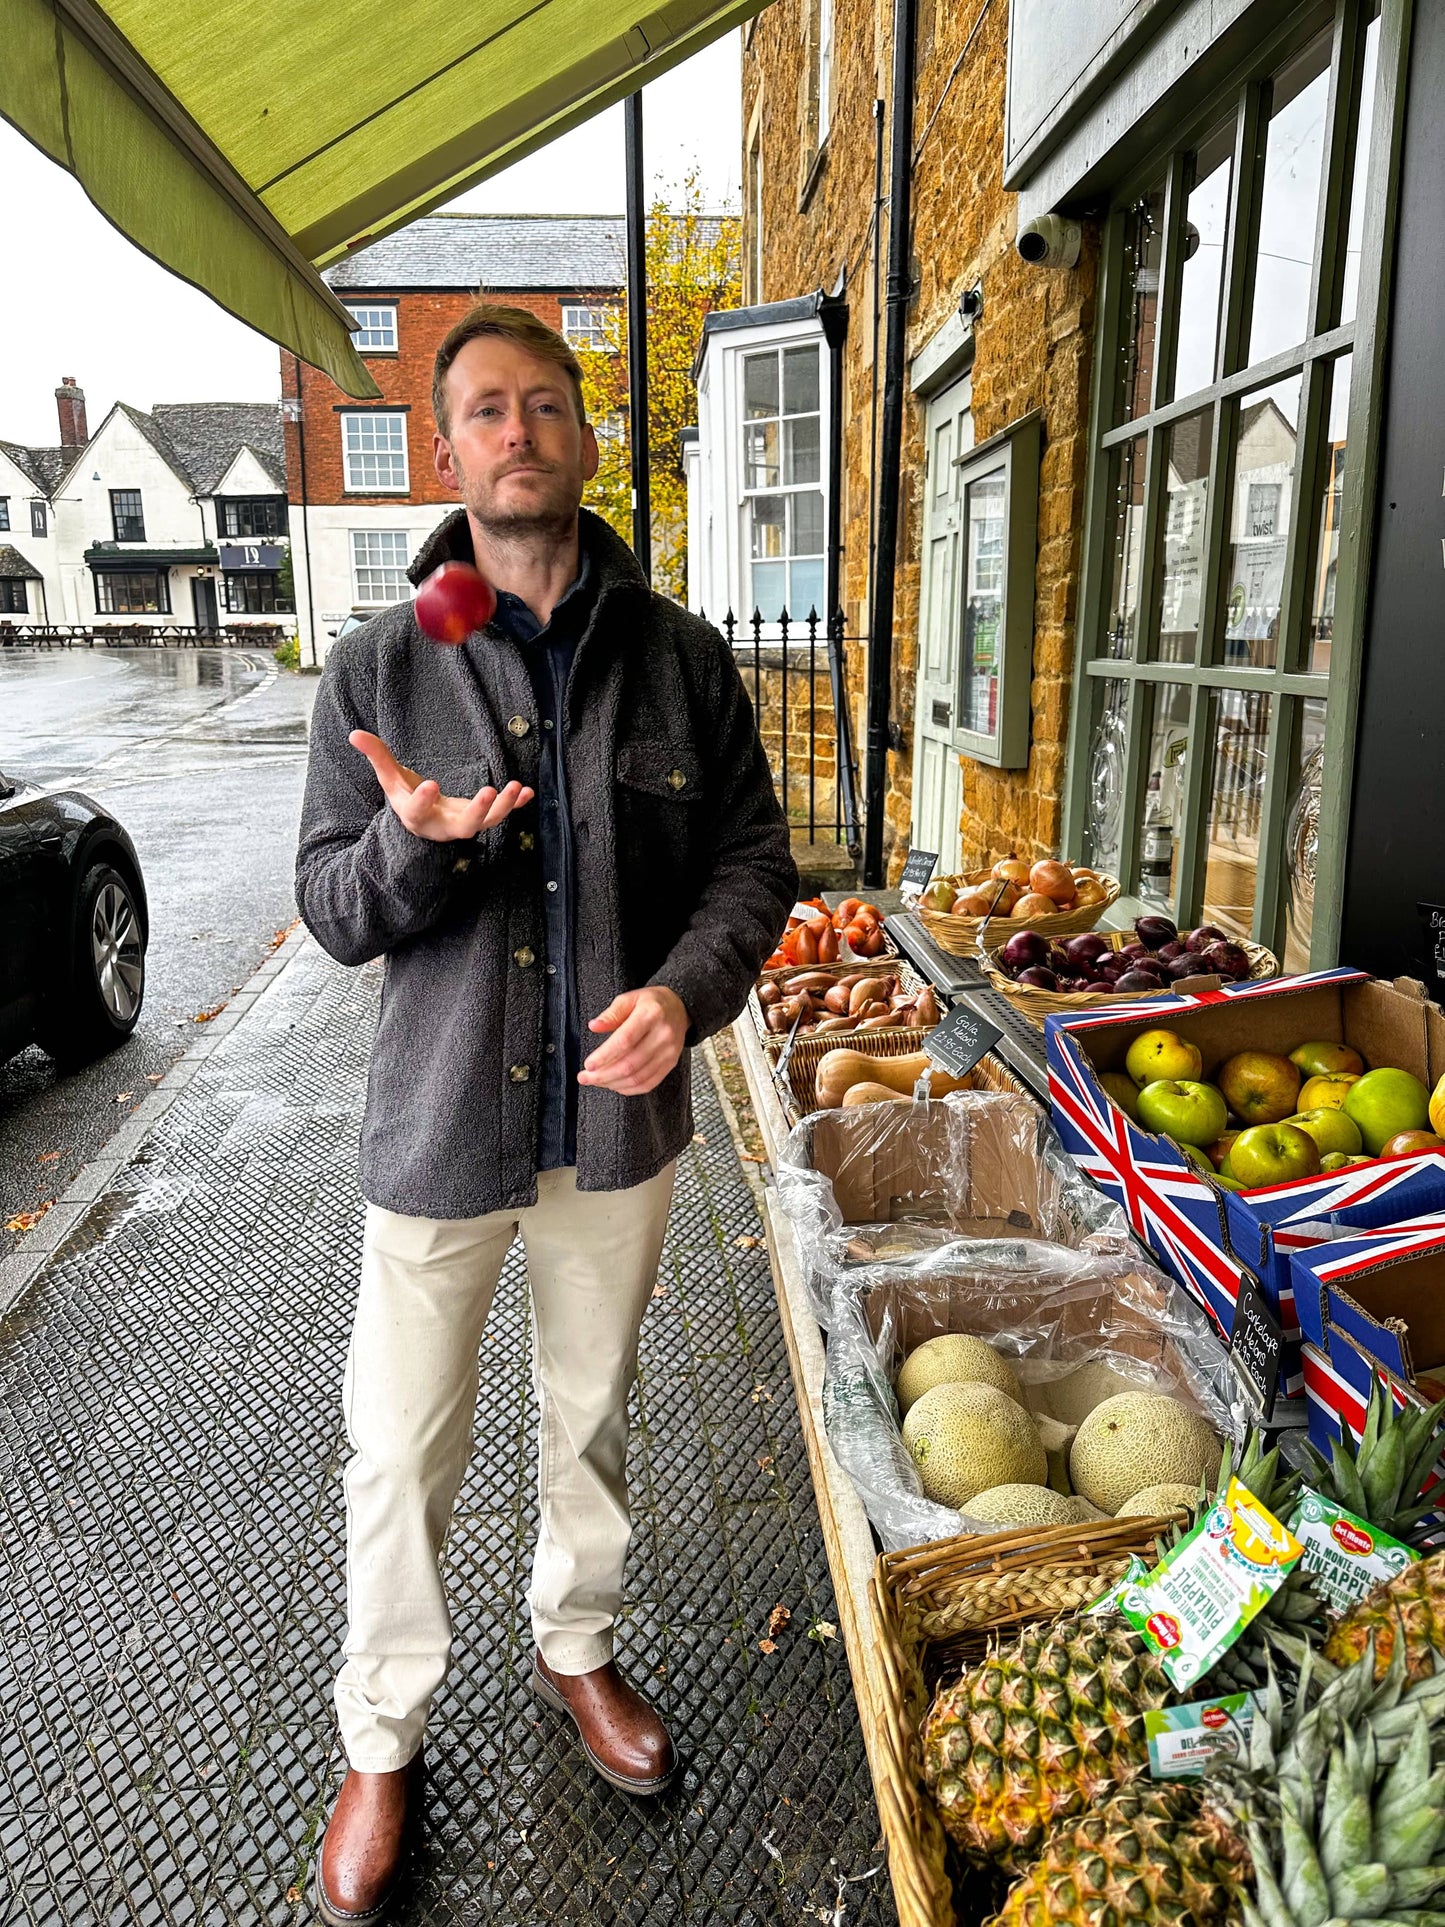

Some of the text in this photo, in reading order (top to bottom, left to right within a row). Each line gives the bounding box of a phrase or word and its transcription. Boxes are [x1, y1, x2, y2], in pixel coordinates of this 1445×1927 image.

[1252, 519, 1273, 537] twist
[950, 1026, 978, 1047] Melons
[955, 1014, 981, 1036] Galia
[1244, 1324, 1266, 1367] Melons
[1250, 1361, 1267, 1396] Each
[1304, 1501, 1317, 1516] 10
[1334, 1523, 1371, 1551] Del Monte
[1302, 1550, 1368, 1602] PINEAPPL
[1304, 1536, 1321, 1554] DEL
[1323, 1547, 1354, 1573] MONTE
[1353, 1565, 1376, 1585] GOL
[1162, 1582, 1211, 1641] DEL MONTE GOLD
[1172, 1566, 1225, 1630] PINEAPPLE
[1150, 1615, 1178, 1647] Del Monte
[1180, 1738, 1197, 1750] DEL
